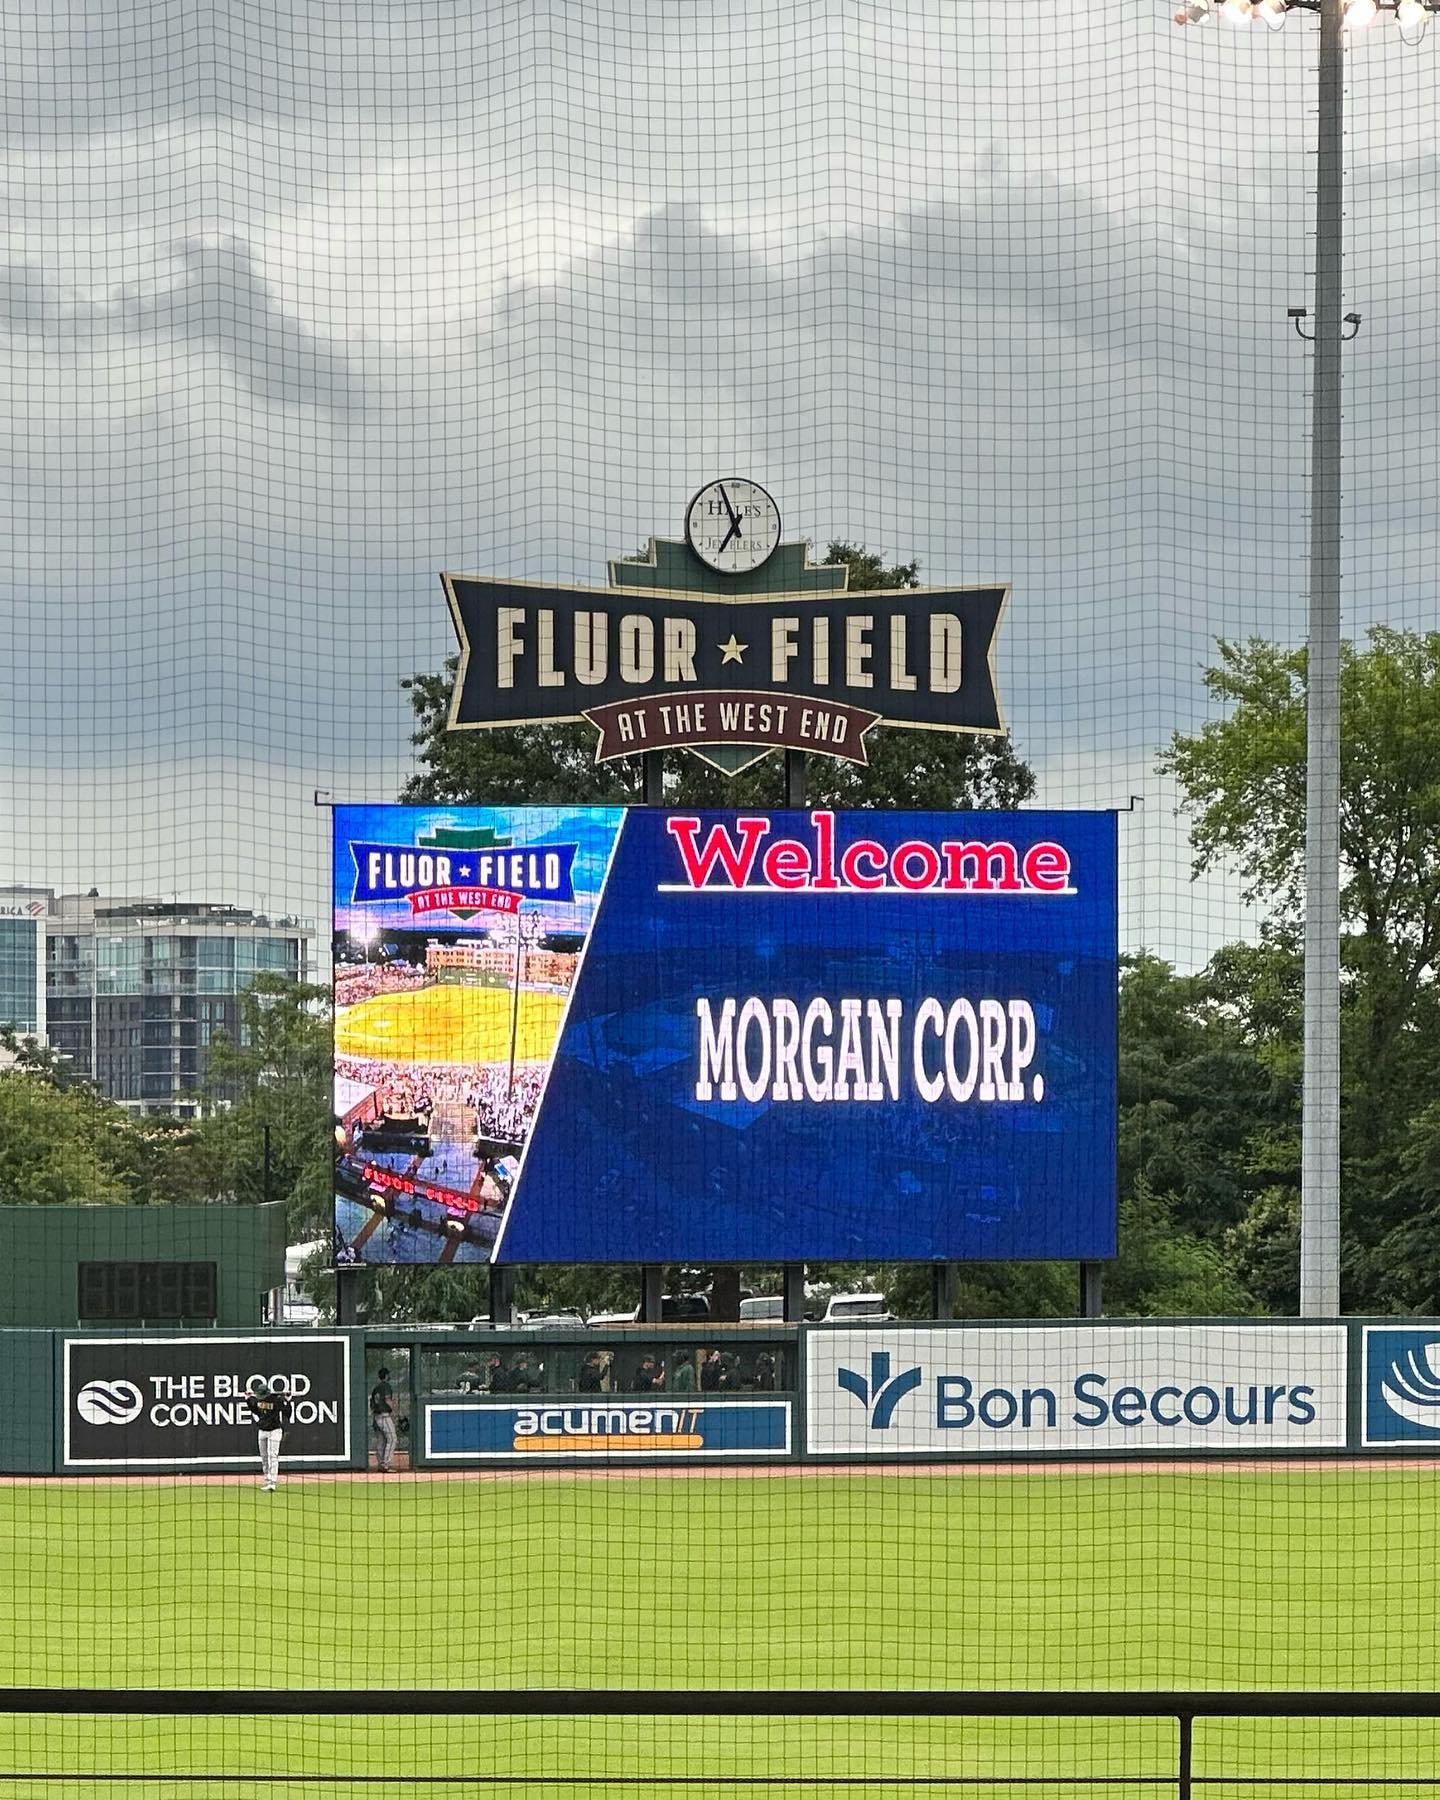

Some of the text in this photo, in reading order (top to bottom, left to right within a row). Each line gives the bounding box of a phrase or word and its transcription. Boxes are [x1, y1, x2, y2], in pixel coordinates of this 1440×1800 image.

[708, 500, 762, 518] HLE'S
[705, 537, 762, 550] JEELERS
[497, 607, 962, 694] FLUOR FIELD
[617, 702, 848, 744] AT THE WEST END
[667, 810, 1071, 891] Welcome
[368, 852, 560, 890] FLUOR FIELD
[418, 892, 511, 909] AT THE WEST END
[696, 997, 1044, 1101] MORGAN CORP.
[150, 1374, 311, 1399] THE BLOOD
[936, 1373, 1316, 1428] Bon Secours
[150, 1400, 338, 1427] CONNEION
